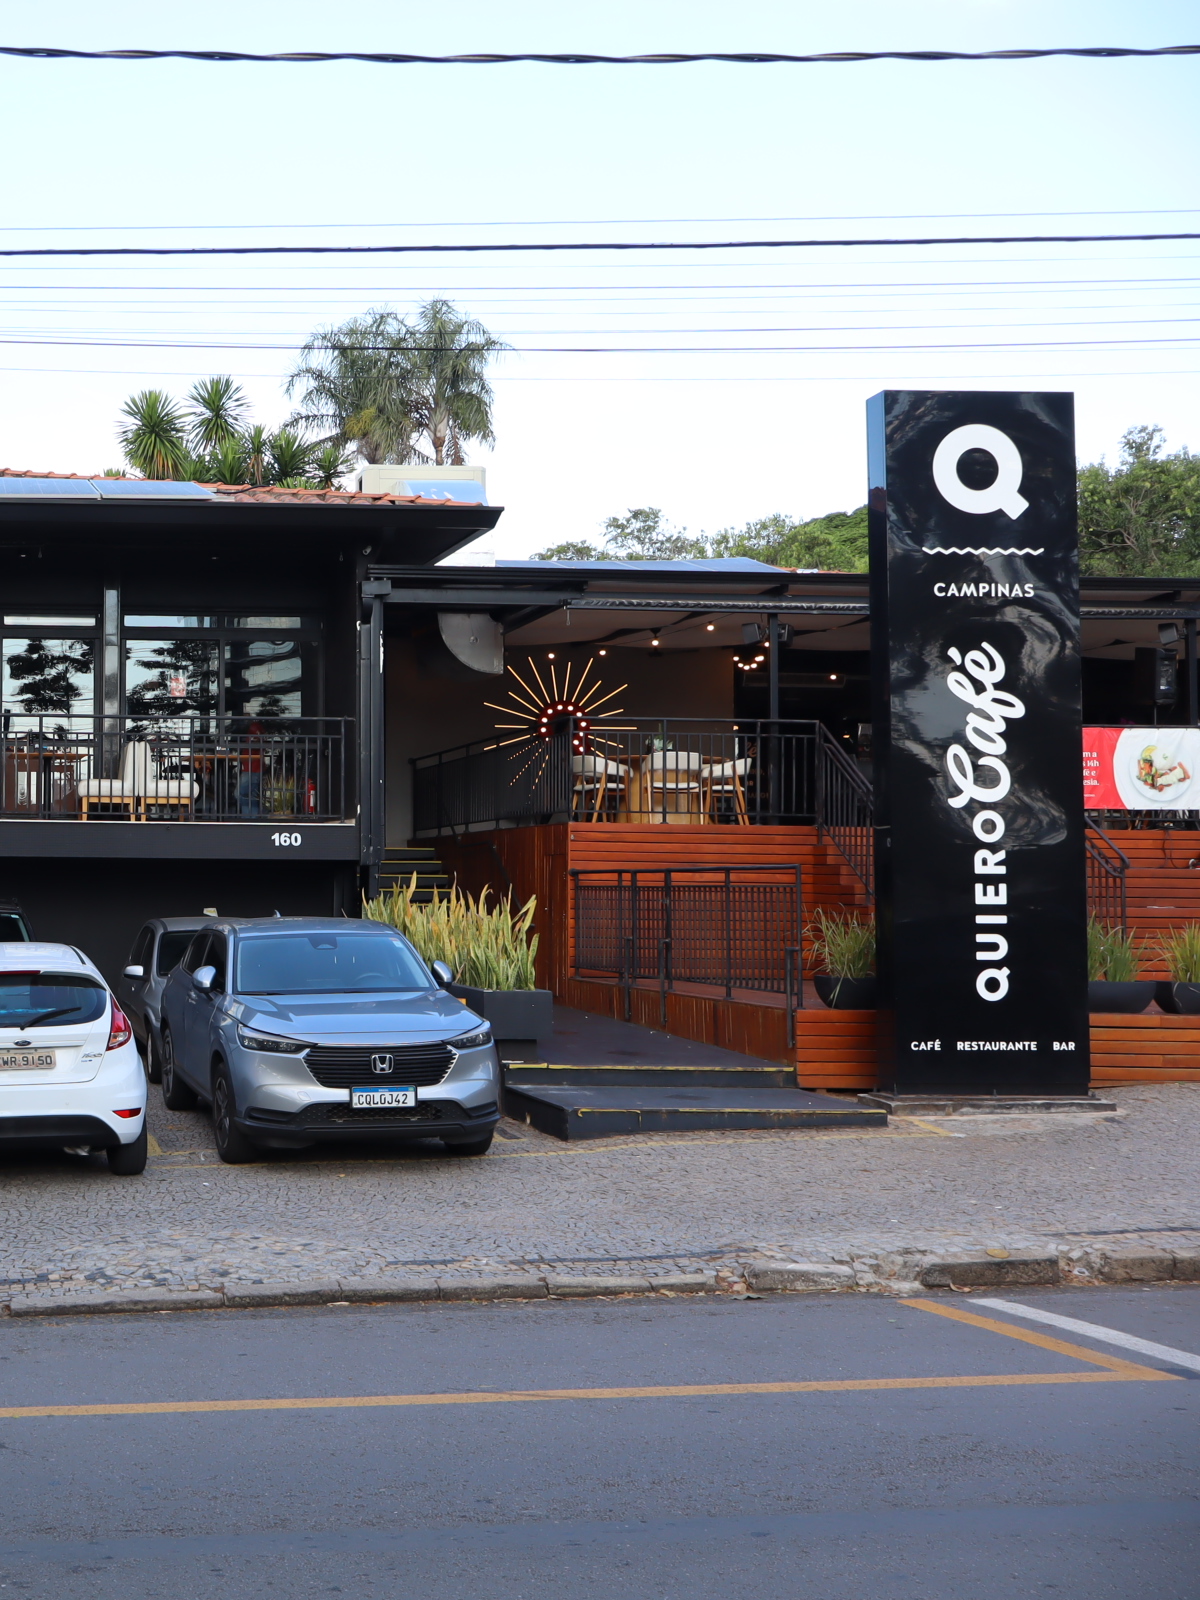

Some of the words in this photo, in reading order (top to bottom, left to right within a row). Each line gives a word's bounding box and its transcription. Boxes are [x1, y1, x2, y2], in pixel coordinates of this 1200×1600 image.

[932, 423, 1030, 521] Q
[933, 582, 1035, 598] CAMPINAS
[946, 641, 1026, 809] Café
[271, 832, 302, 847] 160
[972, 809, 1011, 1002] QUIERO
[910, 1039, 942, 1051] CAFÉ
[956, 1041, 1038, 1051] RESTAURANTE
[1052, 1041, 1076, 1051] BAR
